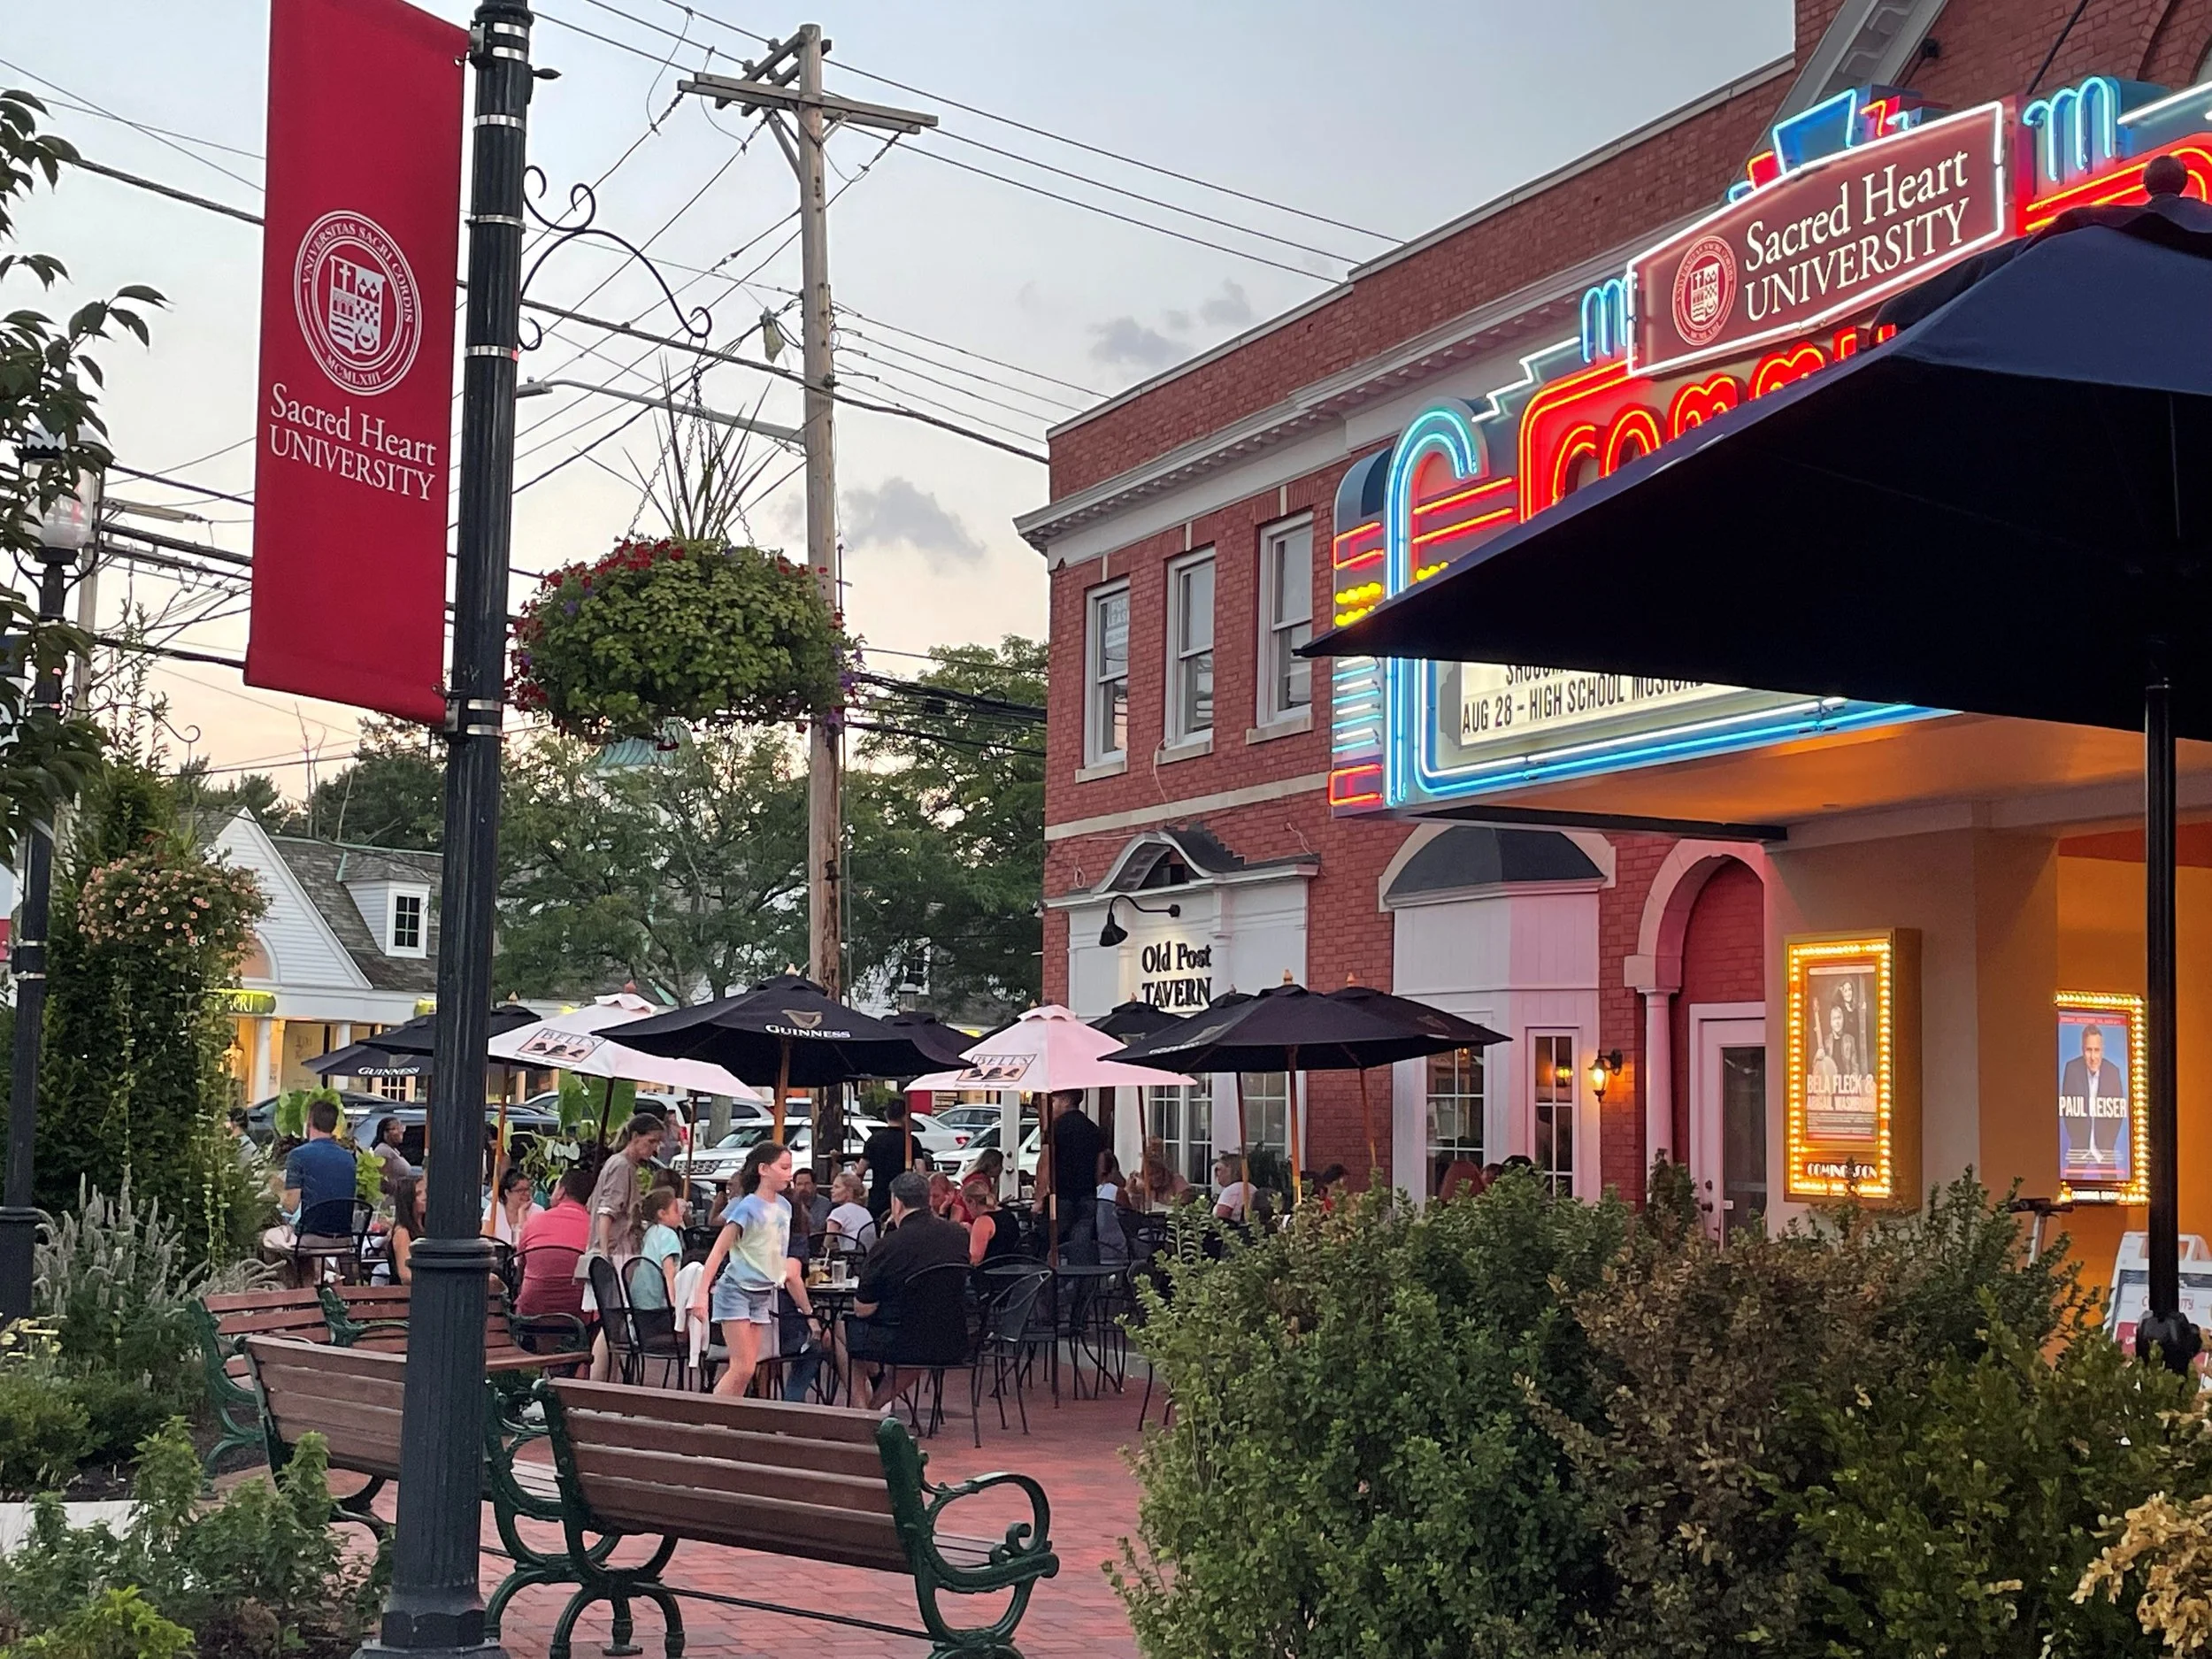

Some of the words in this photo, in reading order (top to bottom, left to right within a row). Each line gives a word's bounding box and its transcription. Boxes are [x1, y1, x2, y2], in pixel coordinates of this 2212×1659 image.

[1745, 180, 1851, 272] Sacred
[1862, 150, 1969, 226] Heart
[358, 227, 393, 262] SACRI
[392, 263, 413, 323] CORDIS
[1745, 197, 1970, 321] UNIVERSITY
[326, 355, 381, 386] MCMLXIII
[271, 382, 351, 441] Sacred
[359, 413, 437, 466] Heart
[269, 424, 436, 501] UNIVERSITY
[1463, 699, 1488, 733] AUG
[1495, 694, 1512, 727] 28
[1530, 682, 1563, 721] HIGH
[1567, 673, 1624, 713] SCHOOL
[1141, 941, 1171, 973] Old
[1176, 942, 1212, 971] Post
[1141, 977, 1212, 1009] TAVERN
[764, 1024, 850, 1039] GUINNESS
[1833, 1073, 1863, 1095] FLECK
[2059, 1095, 2087, 1118] PAUL
[2089, 1096, 2127, 1118] REISER
